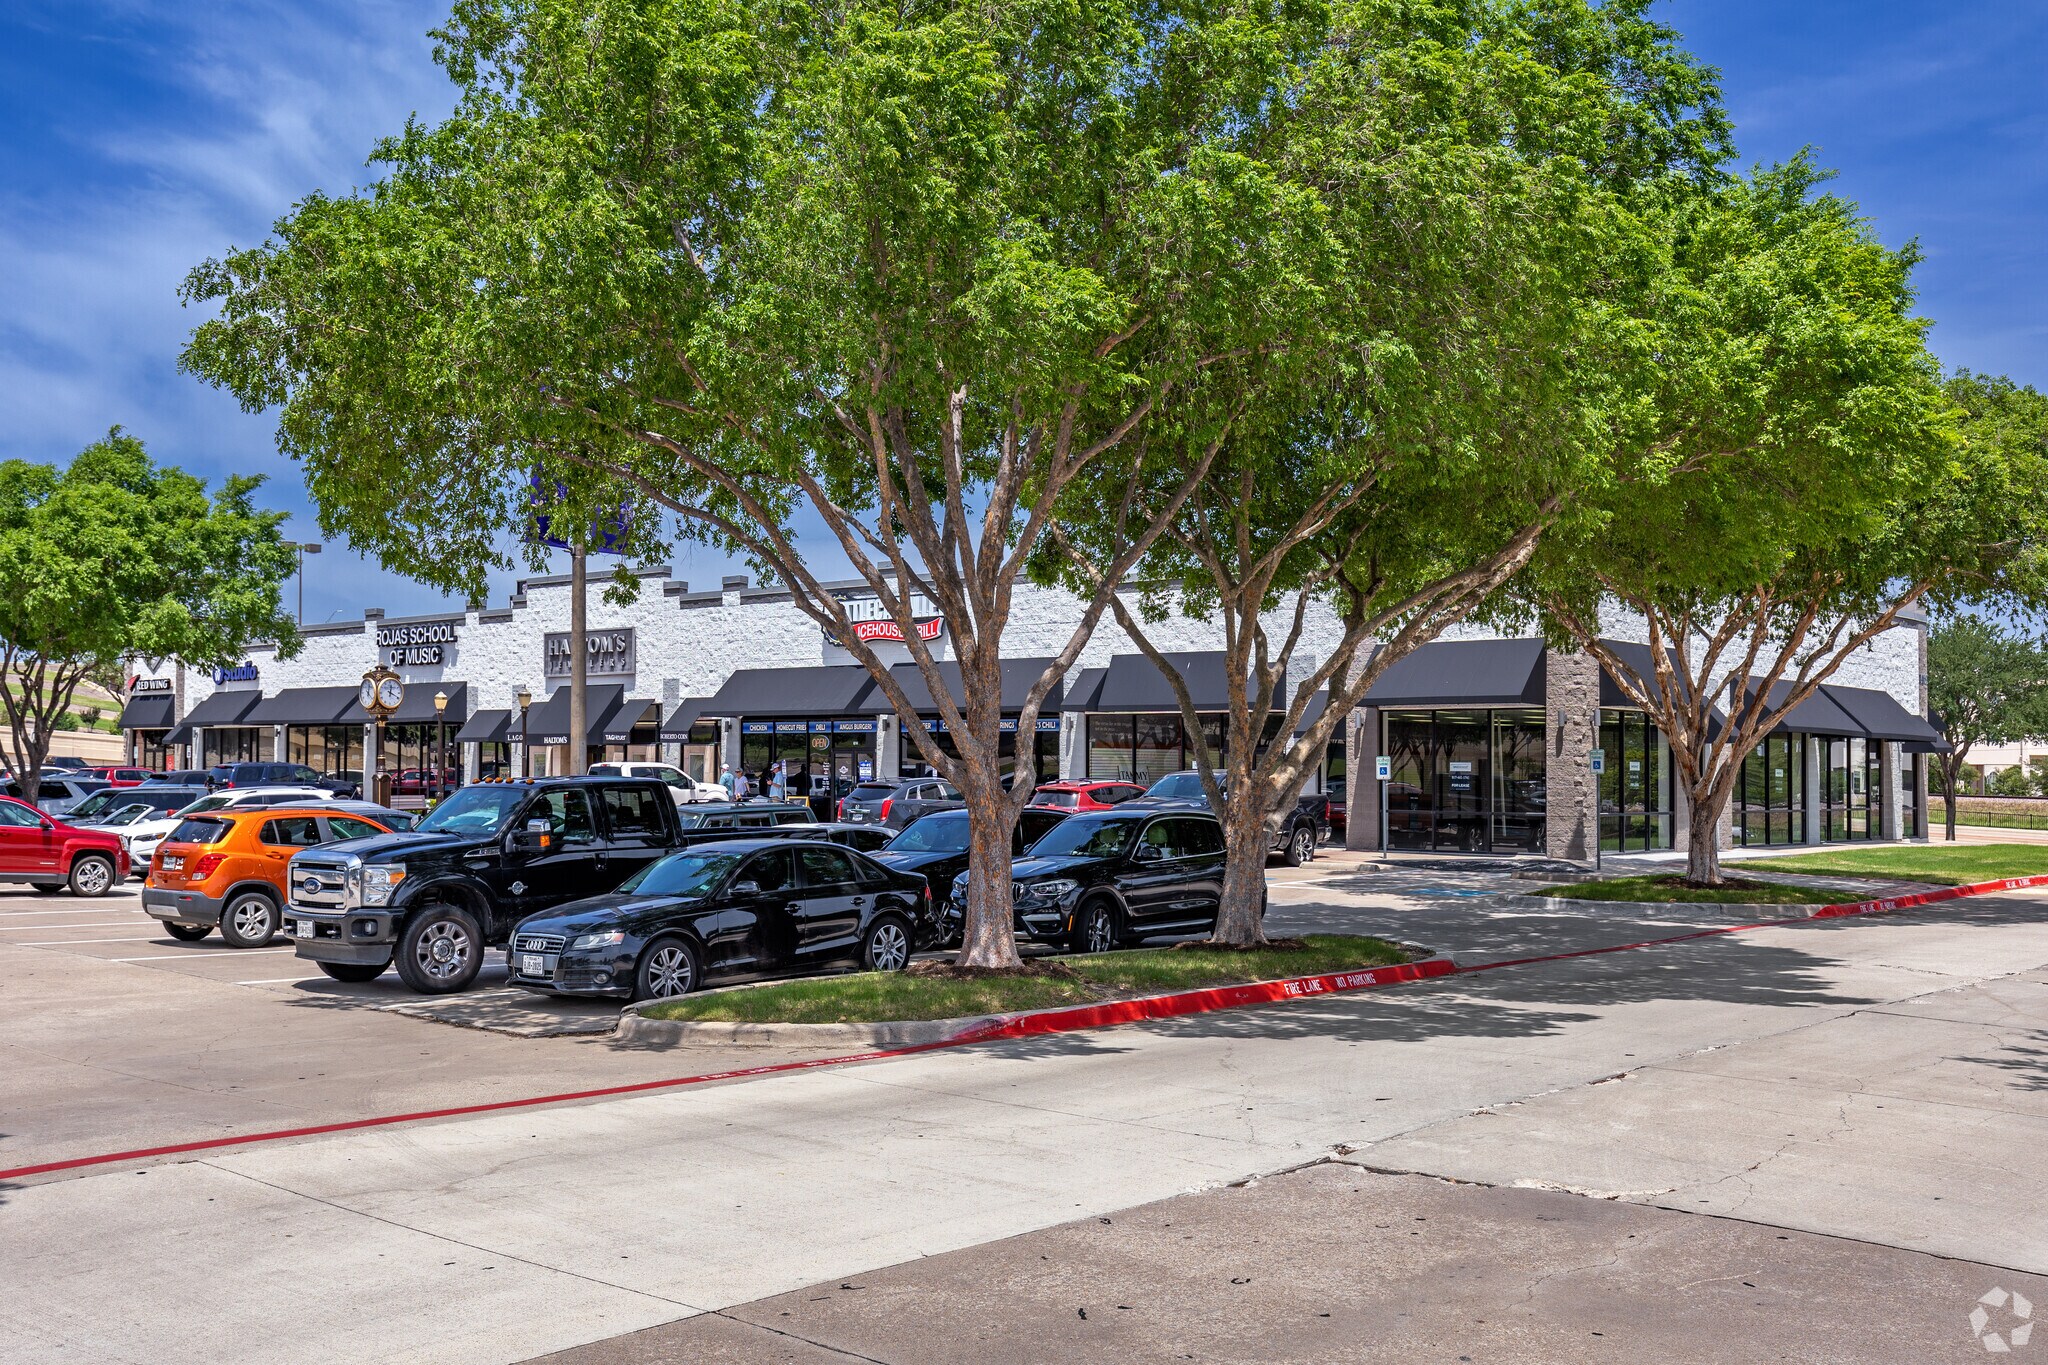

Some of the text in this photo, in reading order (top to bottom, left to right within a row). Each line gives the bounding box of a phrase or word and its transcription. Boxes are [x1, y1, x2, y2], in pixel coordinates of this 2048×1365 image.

[376, 625, 454, 646] ROJAS SCHOOL
[917, 623, 936, 637] RILL
[548, 633, 626, 656] HAOM'S
[389, 647, 439, 665] OF MUSIC
[549, 657, 626, 669] JEWLERS
[136, 680, 168, 690] RED WING
[1042, 721, 1056, 729] CHILI
[811, 738, 827, 748] OPEN
[1284, 972, 1377, 995] FIRE LANE NO PARKING
